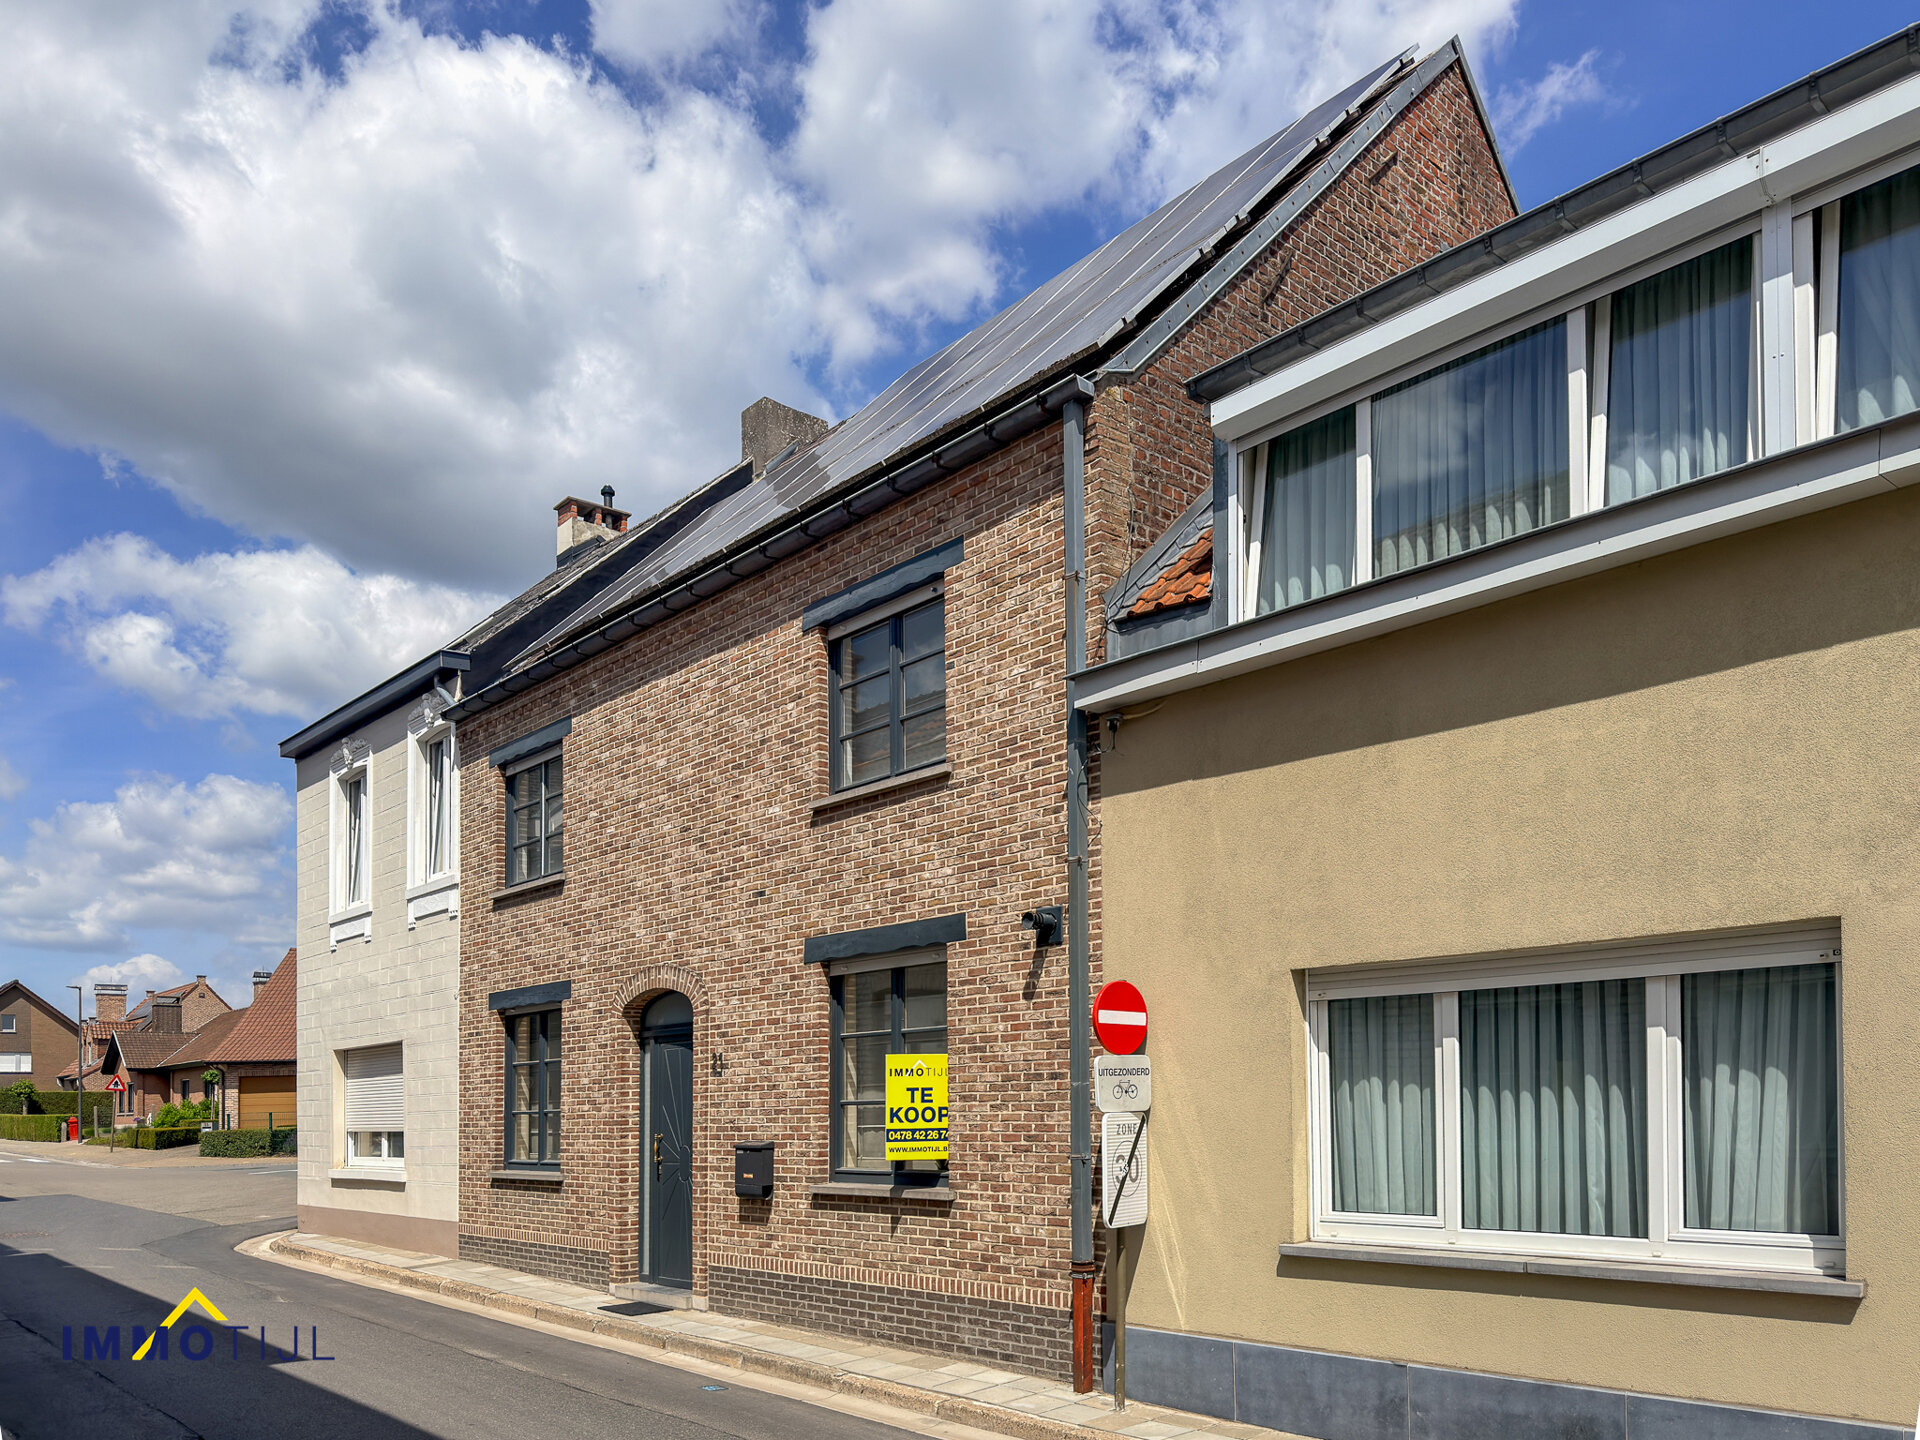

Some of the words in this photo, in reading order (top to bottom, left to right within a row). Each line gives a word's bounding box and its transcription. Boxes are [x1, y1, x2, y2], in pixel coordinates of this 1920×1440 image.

[889, 1068, 948, 1077] IMMOTIJL
[1099, 1068, 1150, 1076] UITGEZONDERD
[906, 1087, 934, 1103] TE
[889, 1106, 948, 1123] KOOP
[1116, 1123, 1138, 1136] ZONE
[889, 1131, 912, 1140] 0478
[914, 1131, 926, 1139] 42
[927, 1131, 939, 1139] 26
